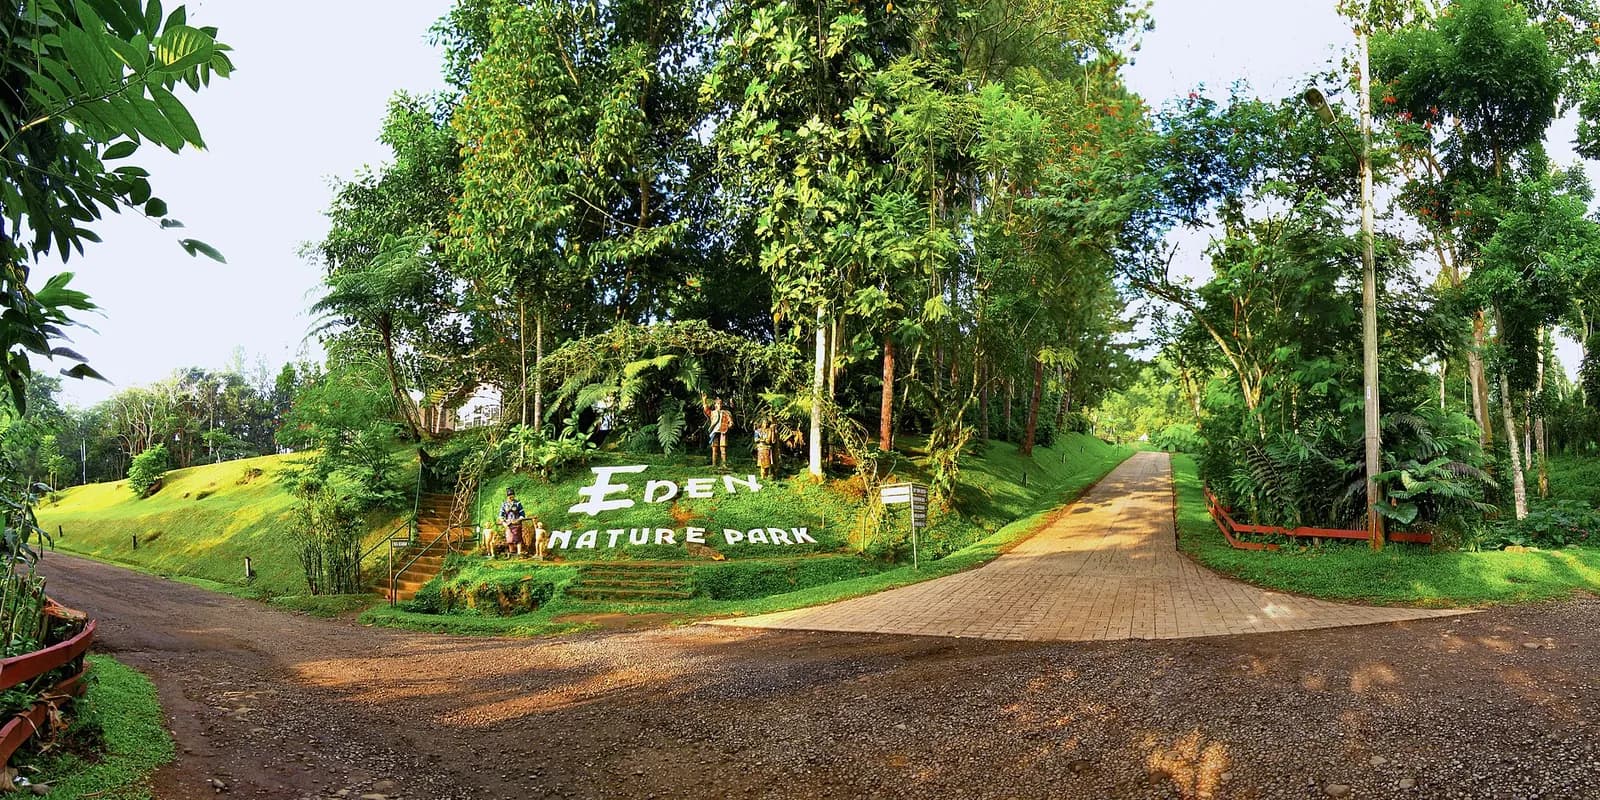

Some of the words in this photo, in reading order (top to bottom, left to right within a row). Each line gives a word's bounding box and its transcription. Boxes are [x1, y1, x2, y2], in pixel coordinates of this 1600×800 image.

[568, 465, 763, 516] EDEN
[547, 527, 706, 550] NATURE
[722, 527, 818, 545] PARK
